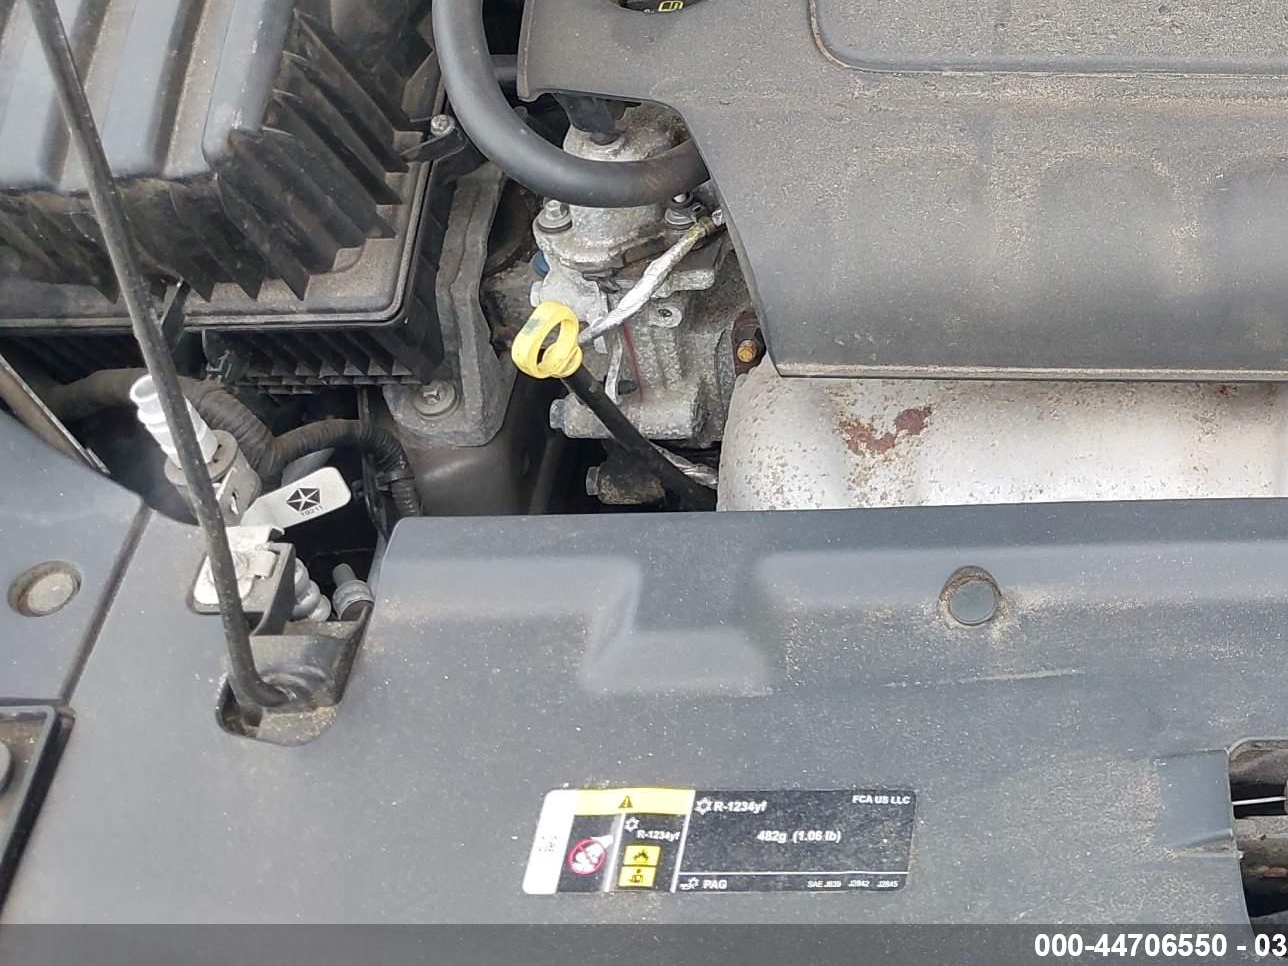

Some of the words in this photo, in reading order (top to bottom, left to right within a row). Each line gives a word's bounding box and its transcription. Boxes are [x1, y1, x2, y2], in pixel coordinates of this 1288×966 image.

[300, 506, 324, 517] 19211
[852, 794, 873, 804] FCA
[874, 795, 889, 804] US
[890, 795, 910, 805] LLC
[713, 800, 768, 815] R-1234yf
[636, 829, 681, 842] R-1234yf
[756, 830, 788, 844] 482g
[792, 830, 824, 844] (1.06
[825, 830, 842, 844] lb)
[703, 879, 728, 890] PAG
[807, 880, 823, 888] SAE
